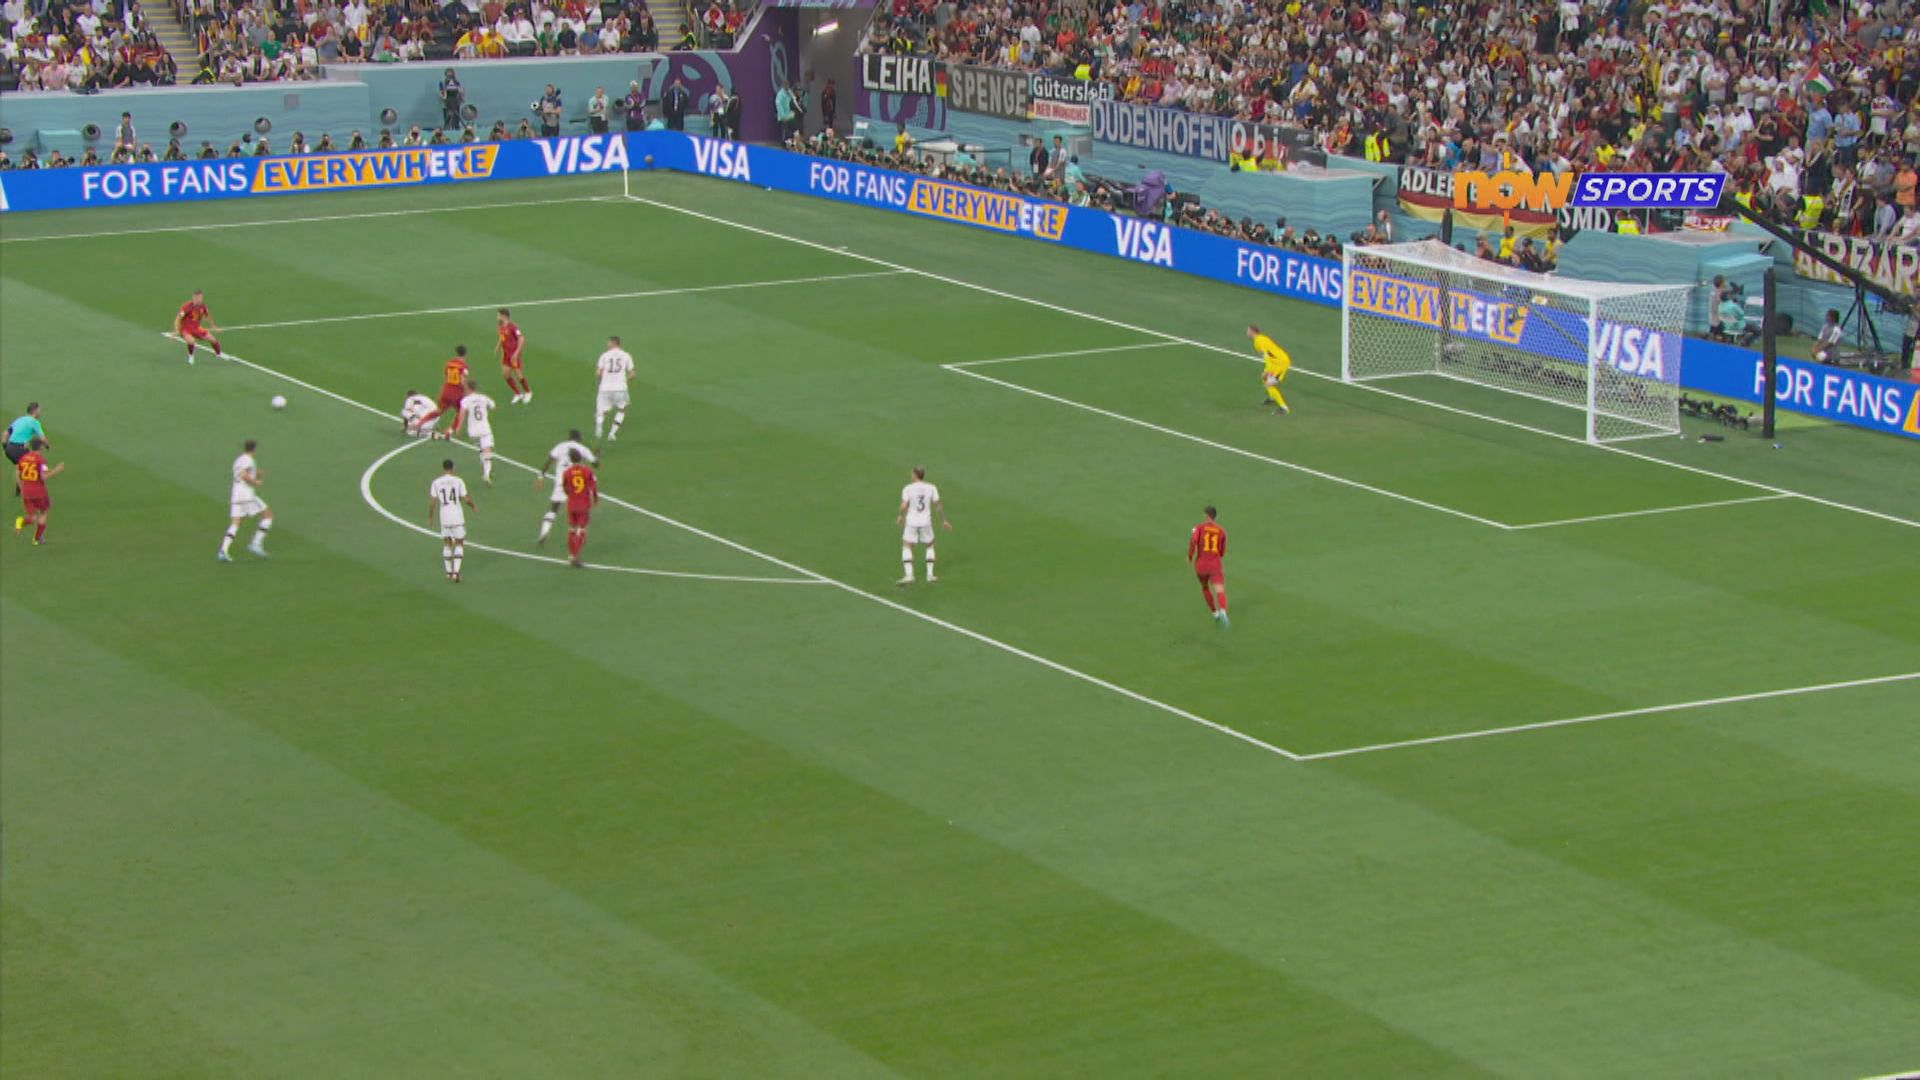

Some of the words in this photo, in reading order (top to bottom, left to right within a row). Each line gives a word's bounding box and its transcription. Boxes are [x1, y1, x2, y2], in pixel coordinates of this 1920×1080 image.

[862, 54, 931, 94] LEIHA
[952, 69, 1028, 116] SPENGE
[1093, 102, 1227, 162] DUDENHOFEN
[82, 169, 151, 200] FOR
[162, 163, 248, 195] FANS
[264, 148, 487, 188] EVERYWHERE
[532, 134, 630, 174] VISA
[688, 135, 751, 182] VISA
[810, 162, 849, 196] FOR
[855, 170, 906, 206] FANS
[916, 182, 1060, 236] EVERYWHERE
[1109, 214, 1173, 267] VISA
[1237, 248, 1280, 286] FOR
[1286, 259, 1342, 300] FANS
[607, 358, 622, 373] 15
[1581, 317, 1664, 380] VISA
[474, 405, 483, 421] 6
[1823, 374, 1900, 425] FANS
[21, 461, 39, 481] 26
[572, 476, 585, 493] 9
[440, 487, 457, 505] 14
[916, 494, 926, 512] 3
[1203, 532, 1219, 553] 11
